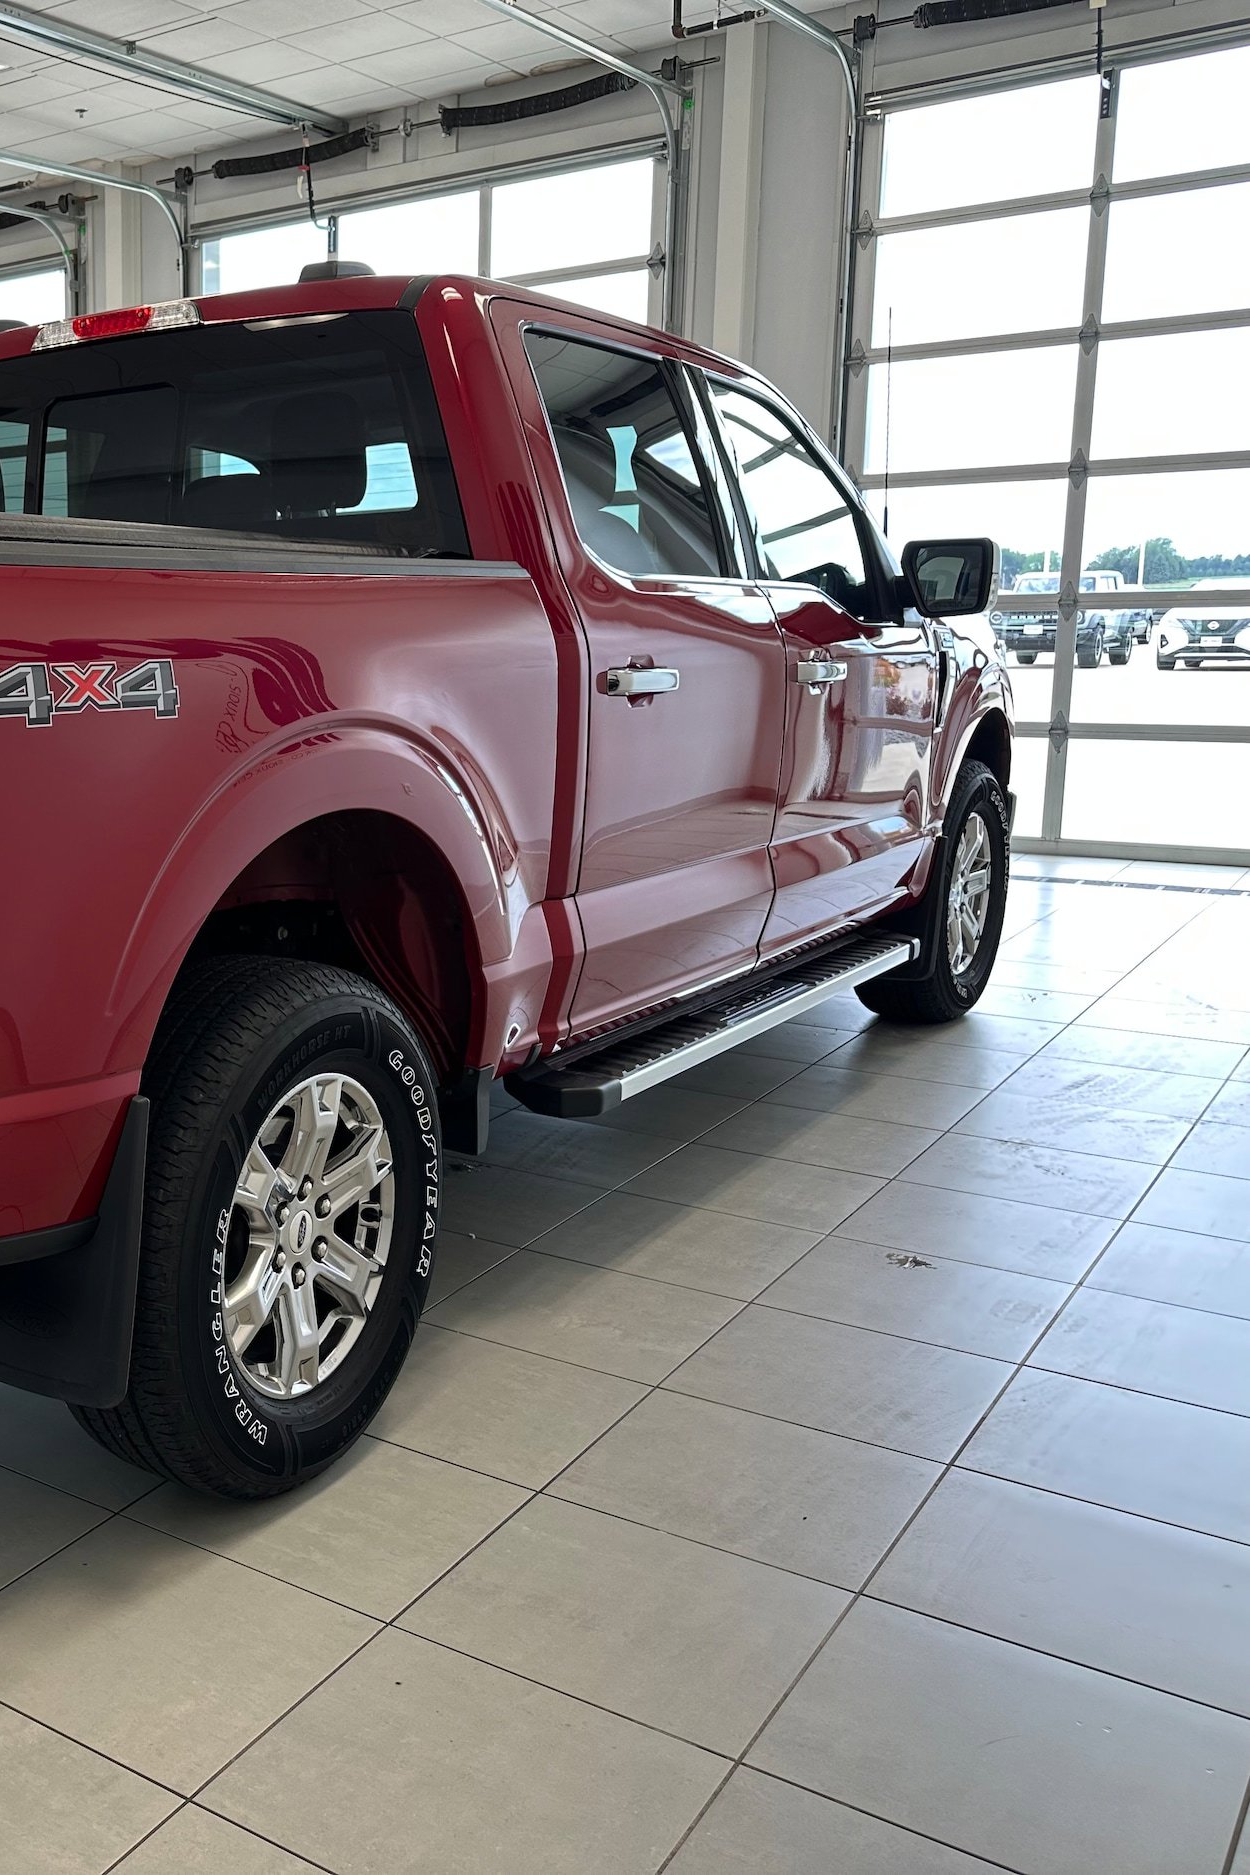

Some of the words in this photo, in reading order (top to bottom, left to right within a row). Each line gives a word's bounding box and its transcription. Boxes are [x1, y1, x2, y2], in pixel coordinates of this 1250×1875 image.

[257, 1030, 331, 1110] WORKHORSE
[335, 1024, 352, 1041] HT
[388, 1049, 440, 1279] GOODYEAR
[208, 1207, 269, 1446] WRANGLER
